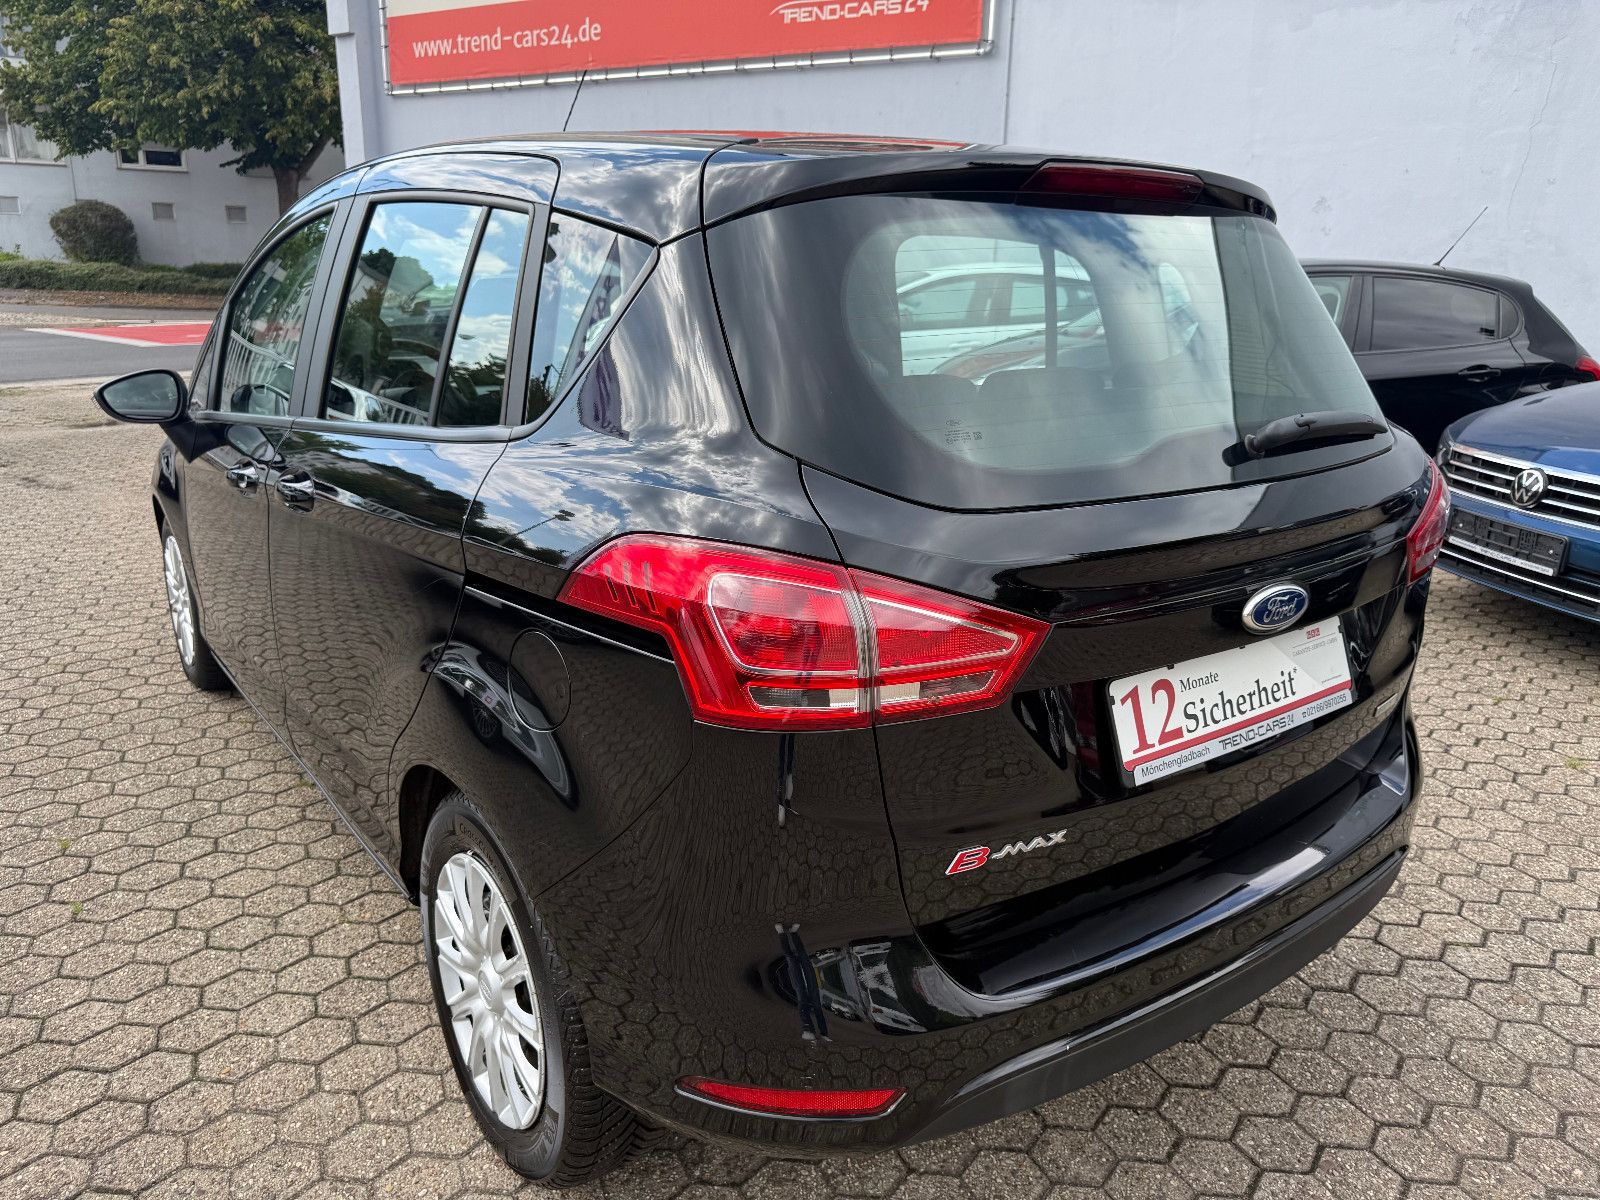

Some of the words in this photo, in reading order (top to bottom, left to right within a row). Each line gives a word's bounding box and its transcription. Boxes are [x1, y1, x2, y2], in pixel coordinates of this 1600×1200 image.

[412, 16, 602, 59] www.trend-cars24.de
[1262, 593, 1300, 623] Ford
[1120, 678, 1184, 755] 12
[1178, 671, 1219, 693] Monate
[1141, 745, 1211, 778] Mönchengladbach
[944, 828, 1068, 876] B-MAX
